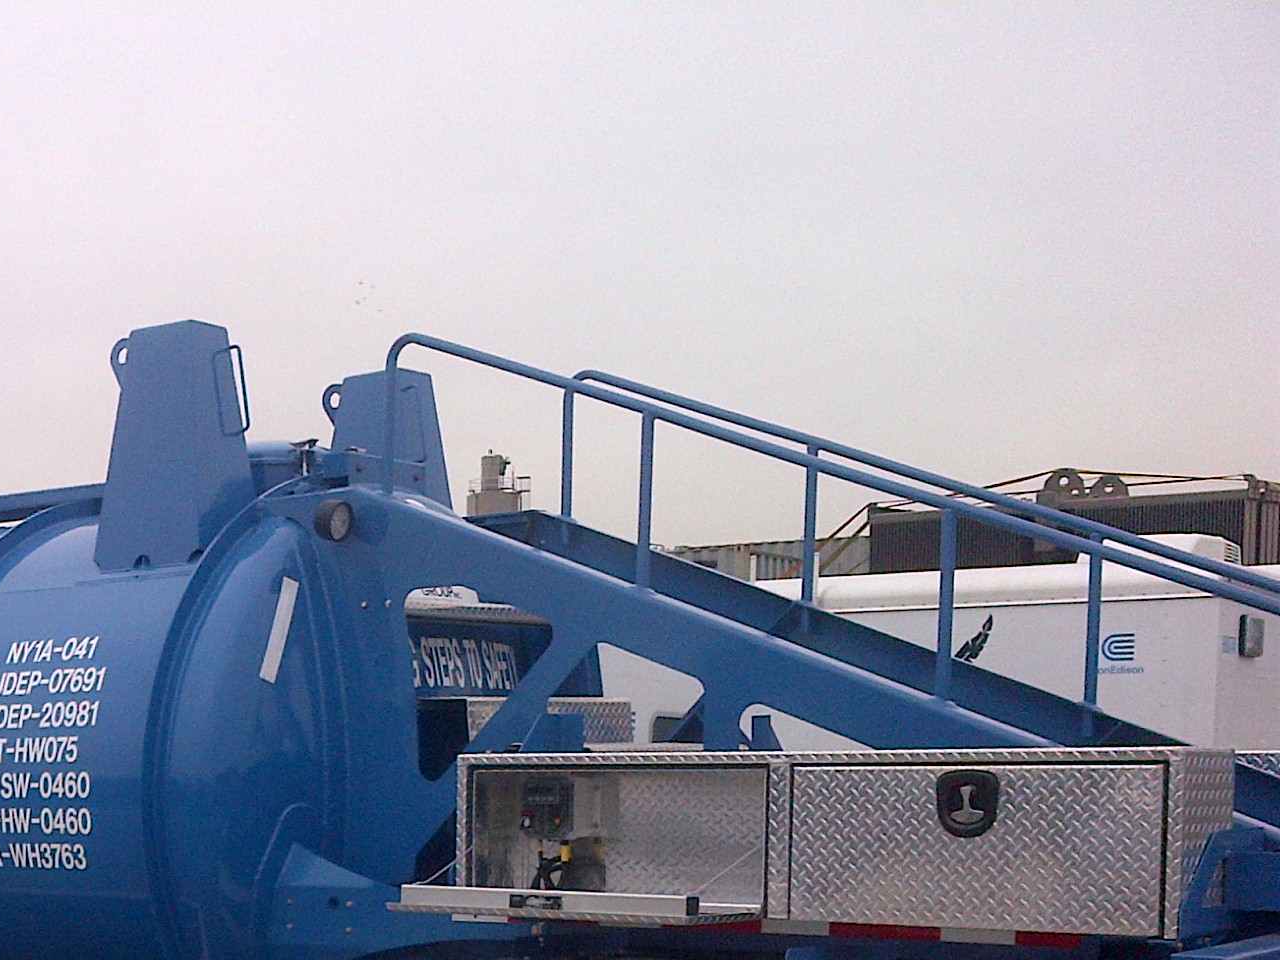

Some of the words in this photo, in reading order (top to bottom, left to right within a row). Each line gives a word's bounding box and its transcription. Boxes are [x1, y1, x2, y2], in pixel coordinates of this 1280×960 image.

[6, 636, 99, 664] NY1A-041
[420, 636, 465, 688] STEPS
[463, 638, 483, 689] TO
[1098, 665, 1145, 675] onEdison
